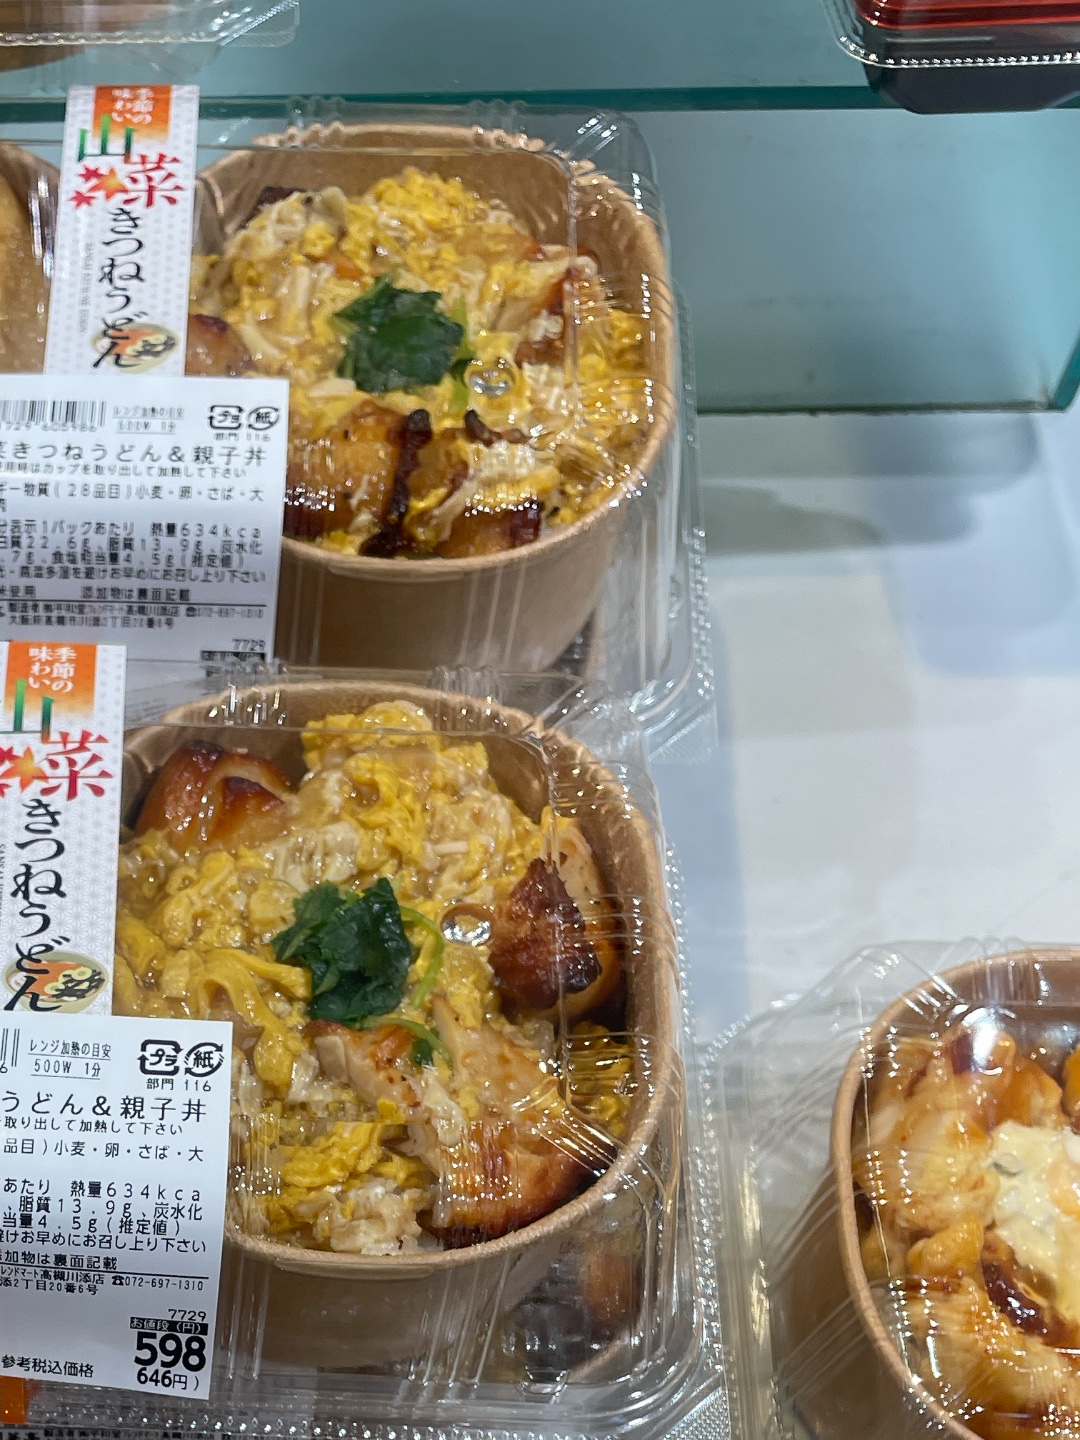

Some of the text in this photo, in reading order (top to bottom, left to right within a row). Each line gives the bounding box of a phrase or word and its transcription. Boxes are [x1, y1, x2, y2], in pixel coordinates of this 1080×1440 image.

[78, 114, 184, 208] 山菜
[92, 207, 148, 369] きつねうどん
[28, 646, 54, 690] 味わい
[52, 646, 77, 694] 季節の
[3, 798, 71, 1012] きつねうどん
[29, 1038, 112, 1059] レンジ加熱の目安
[34, 1058, 101, 1078] 500W 1分
[146, 1077, 212, 1092] 部門 116
[167, 1308, 207, 1323] 7729
[133, 1330, 207, 1373] 598
